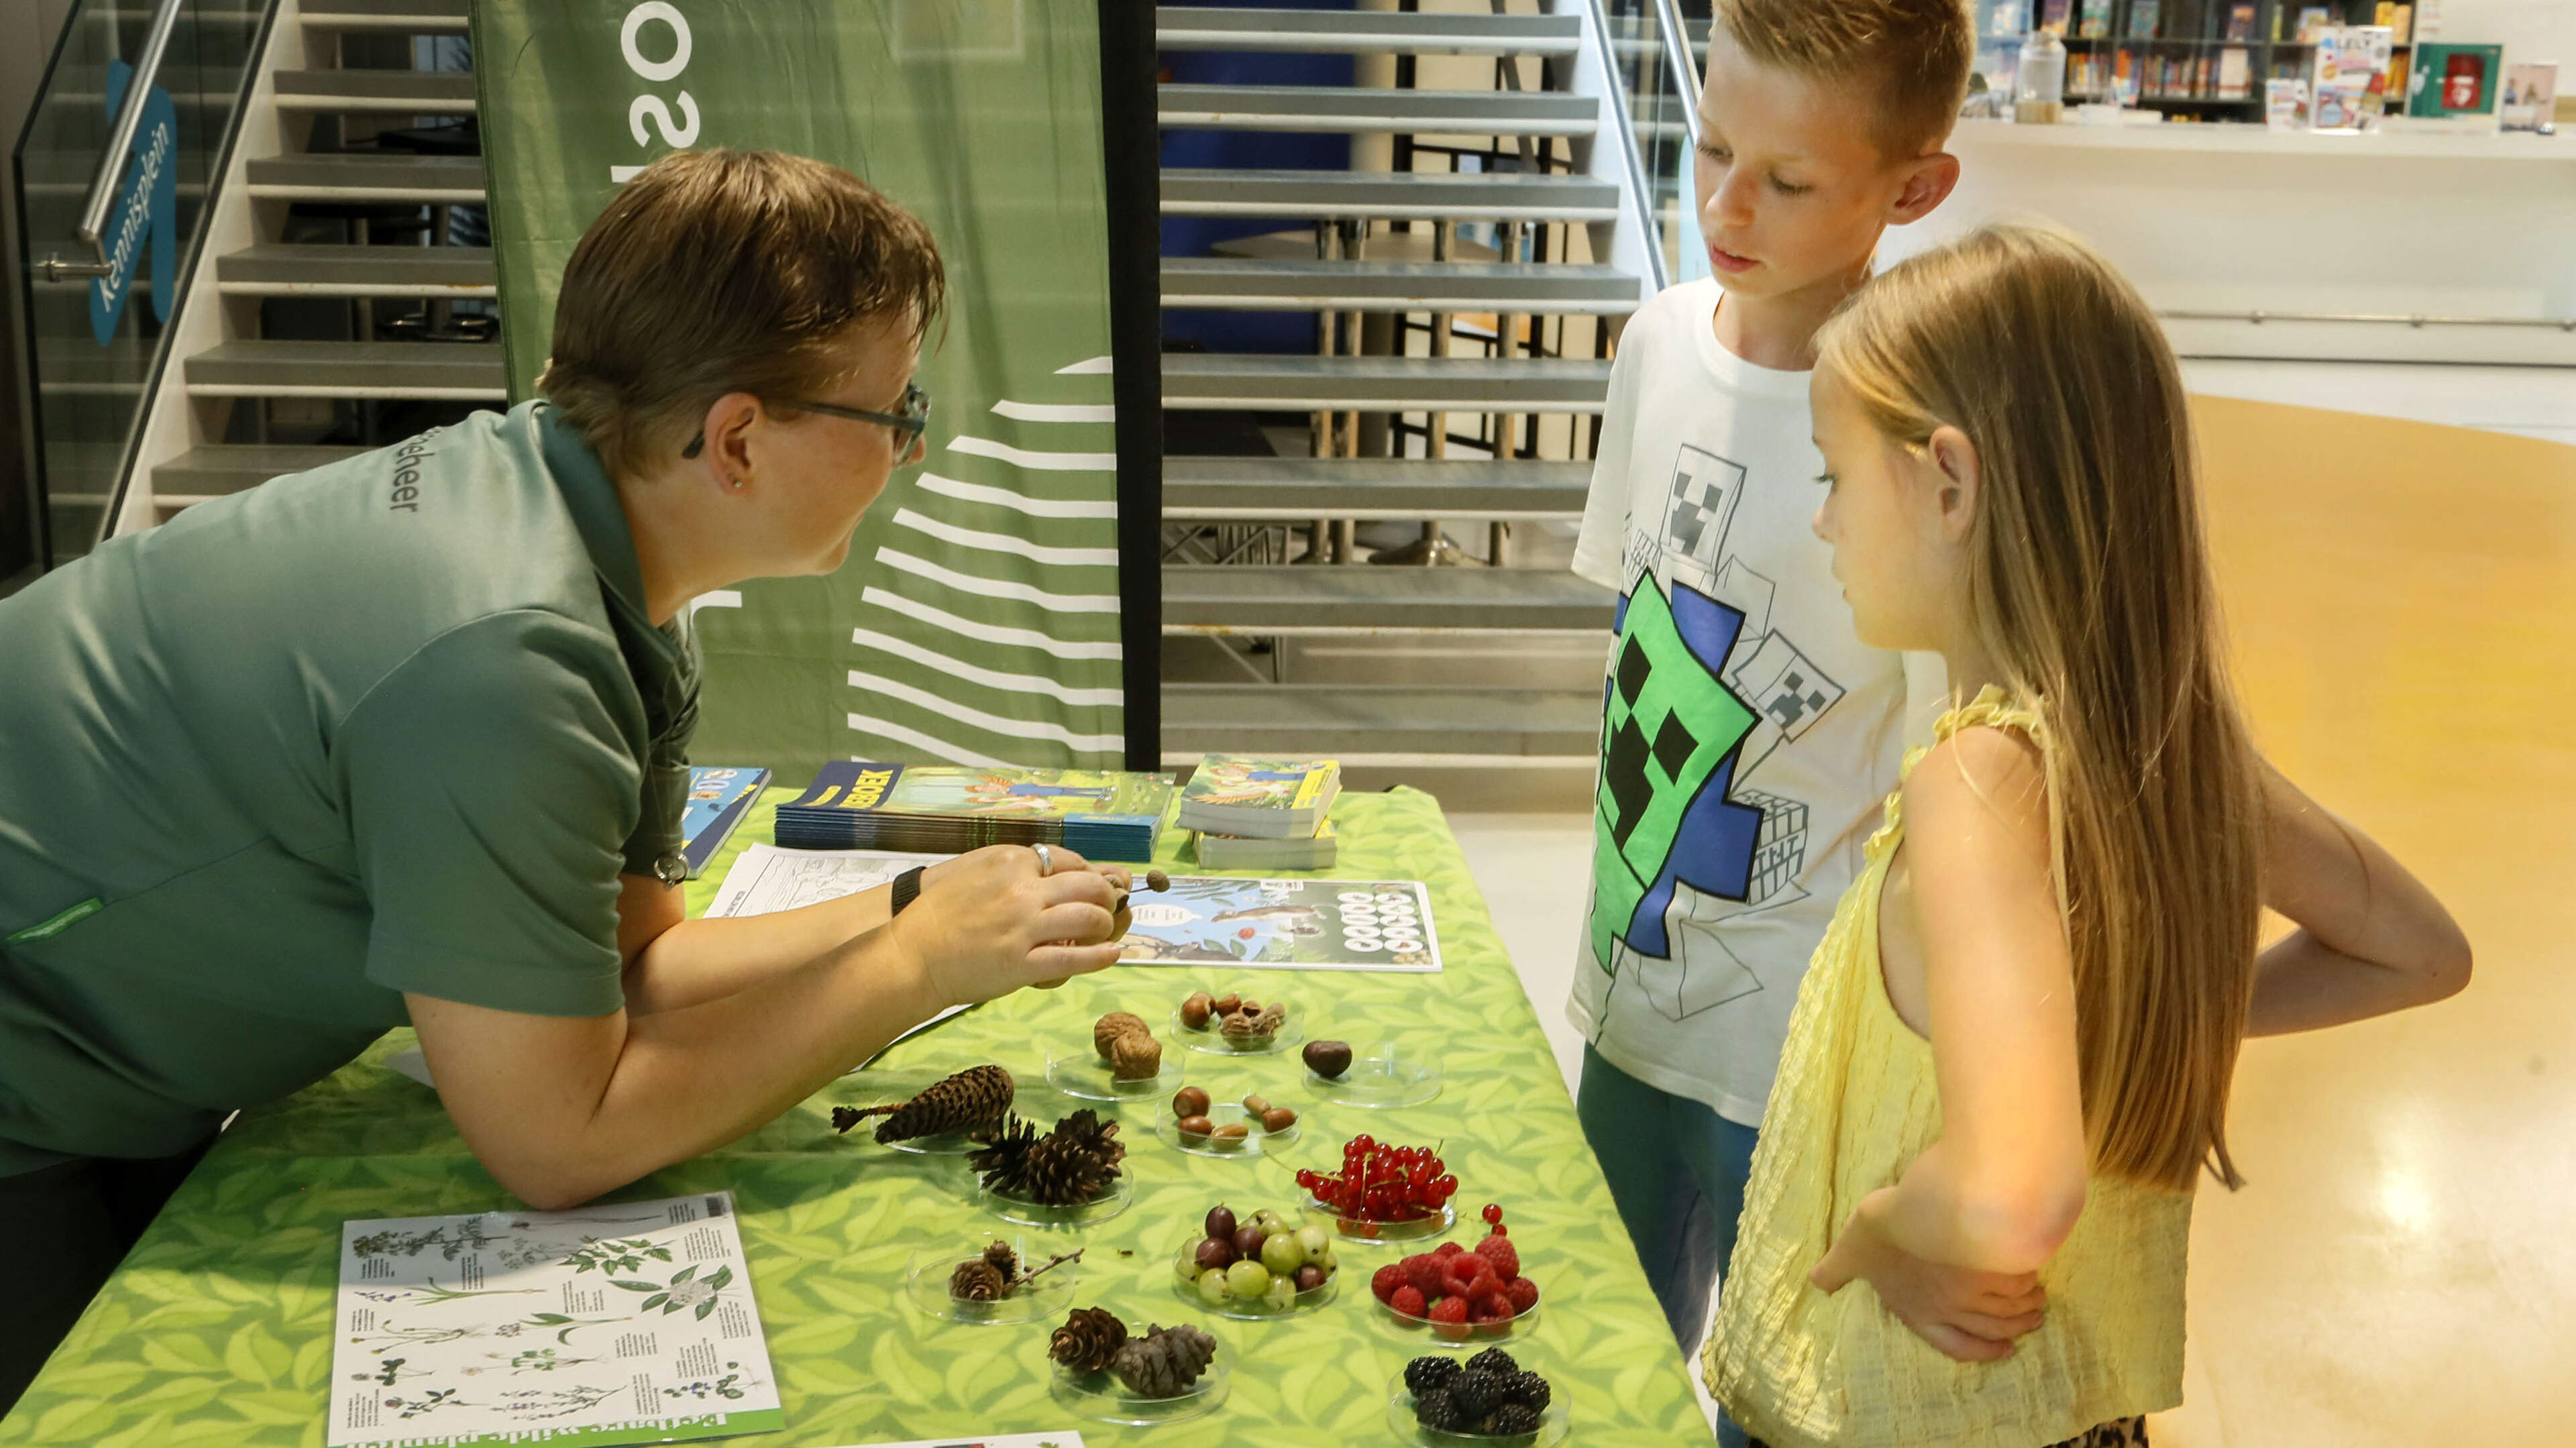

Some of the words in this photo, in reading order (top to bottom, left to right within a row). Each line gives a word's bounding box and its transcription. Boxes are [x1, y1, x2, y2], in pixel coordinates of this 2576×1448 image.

[1756, 834, 1799, 873] TNT
[590, 1412, 728, 1434] Eetbare
[488, 1425, 580, 1445] wilde
